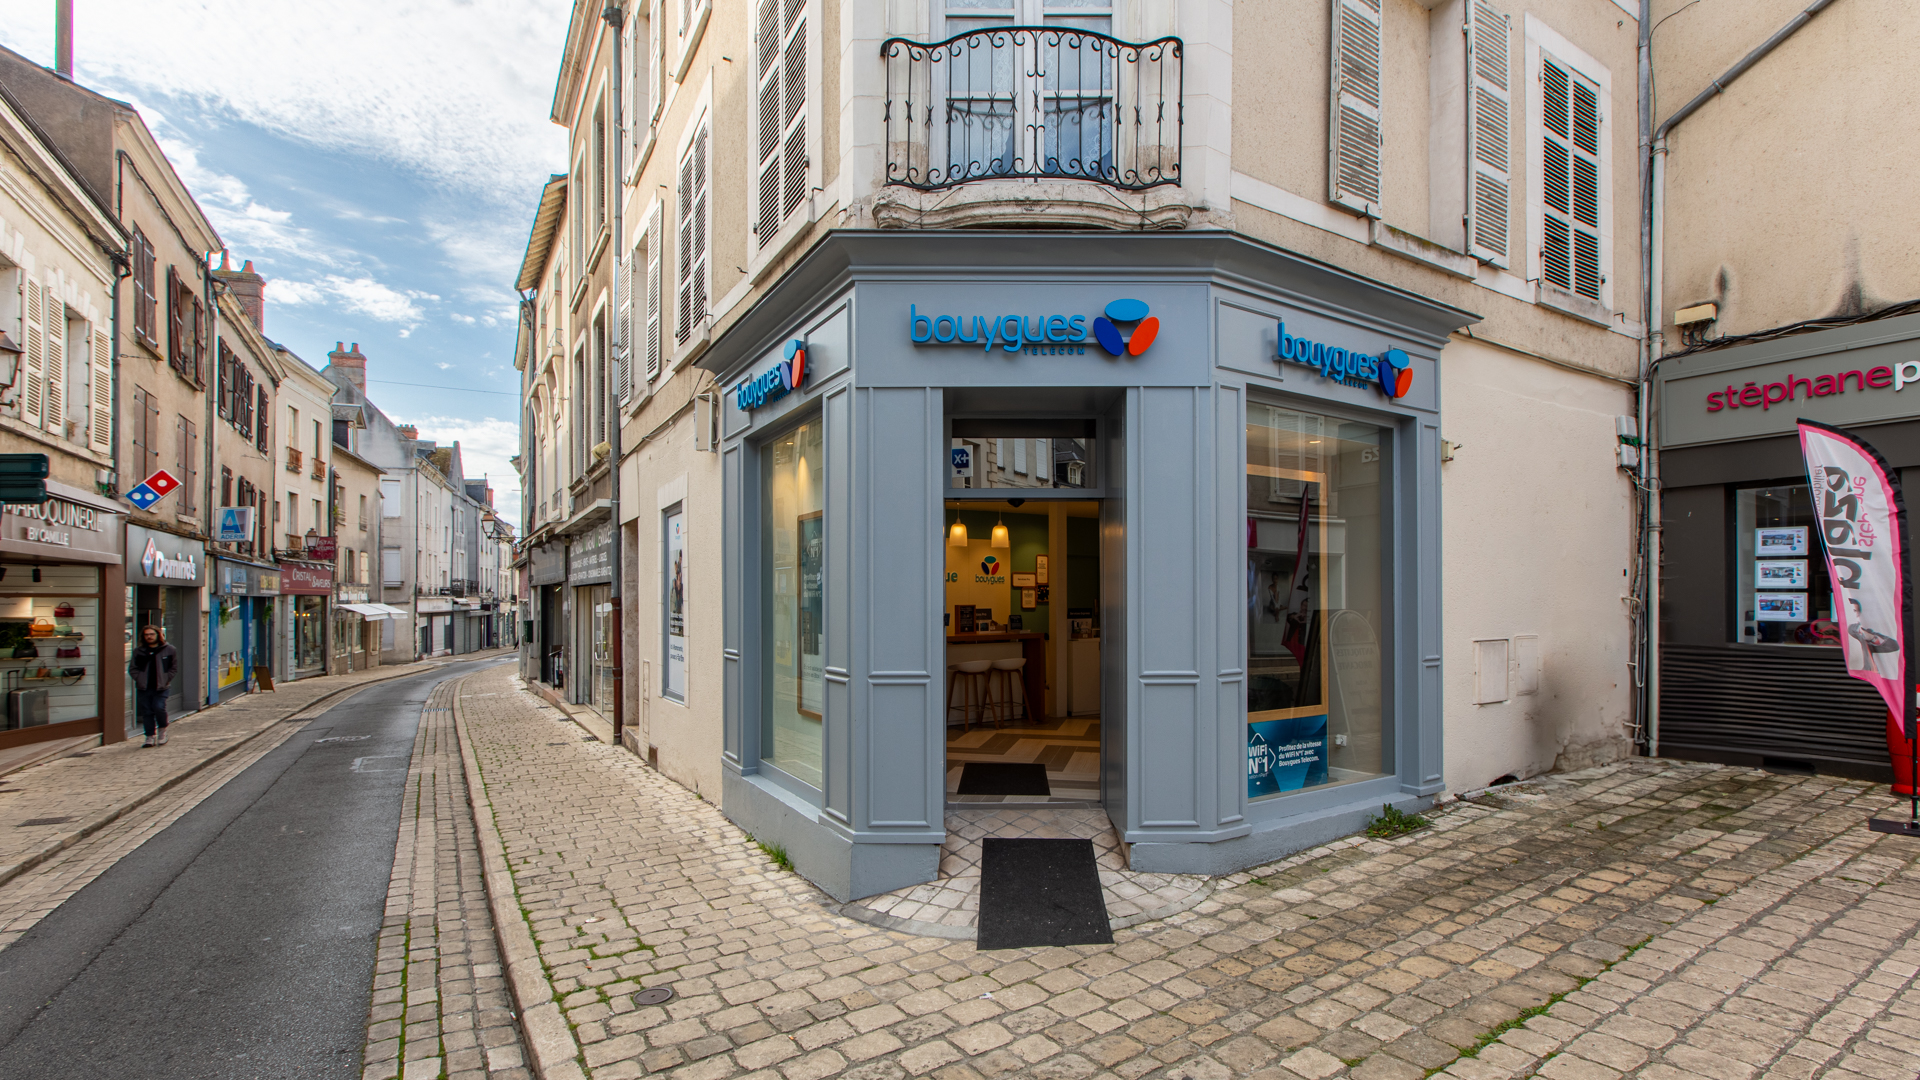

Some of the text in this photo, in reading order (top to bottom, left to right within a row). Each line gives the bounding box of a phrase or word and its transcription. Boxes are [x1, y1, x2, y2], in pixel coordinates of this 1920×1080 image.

[911, 304, 1087, 352] bouygues
[1023, 347, 1086, 356] TELECOM
[1278, 322, 1379, 381] bouygues
[736, 363, 781, 410] bouygues
[1335, 379, 1369, 390] ELECOM
[27, 526, 40, 541] BY
[153, 550, 197, 581] Domino's
[974, 574, 1005, 585] bouygues
[1248, 744, 1268, 757] WiFi
[1248, 756, 1268, 775] N°1
